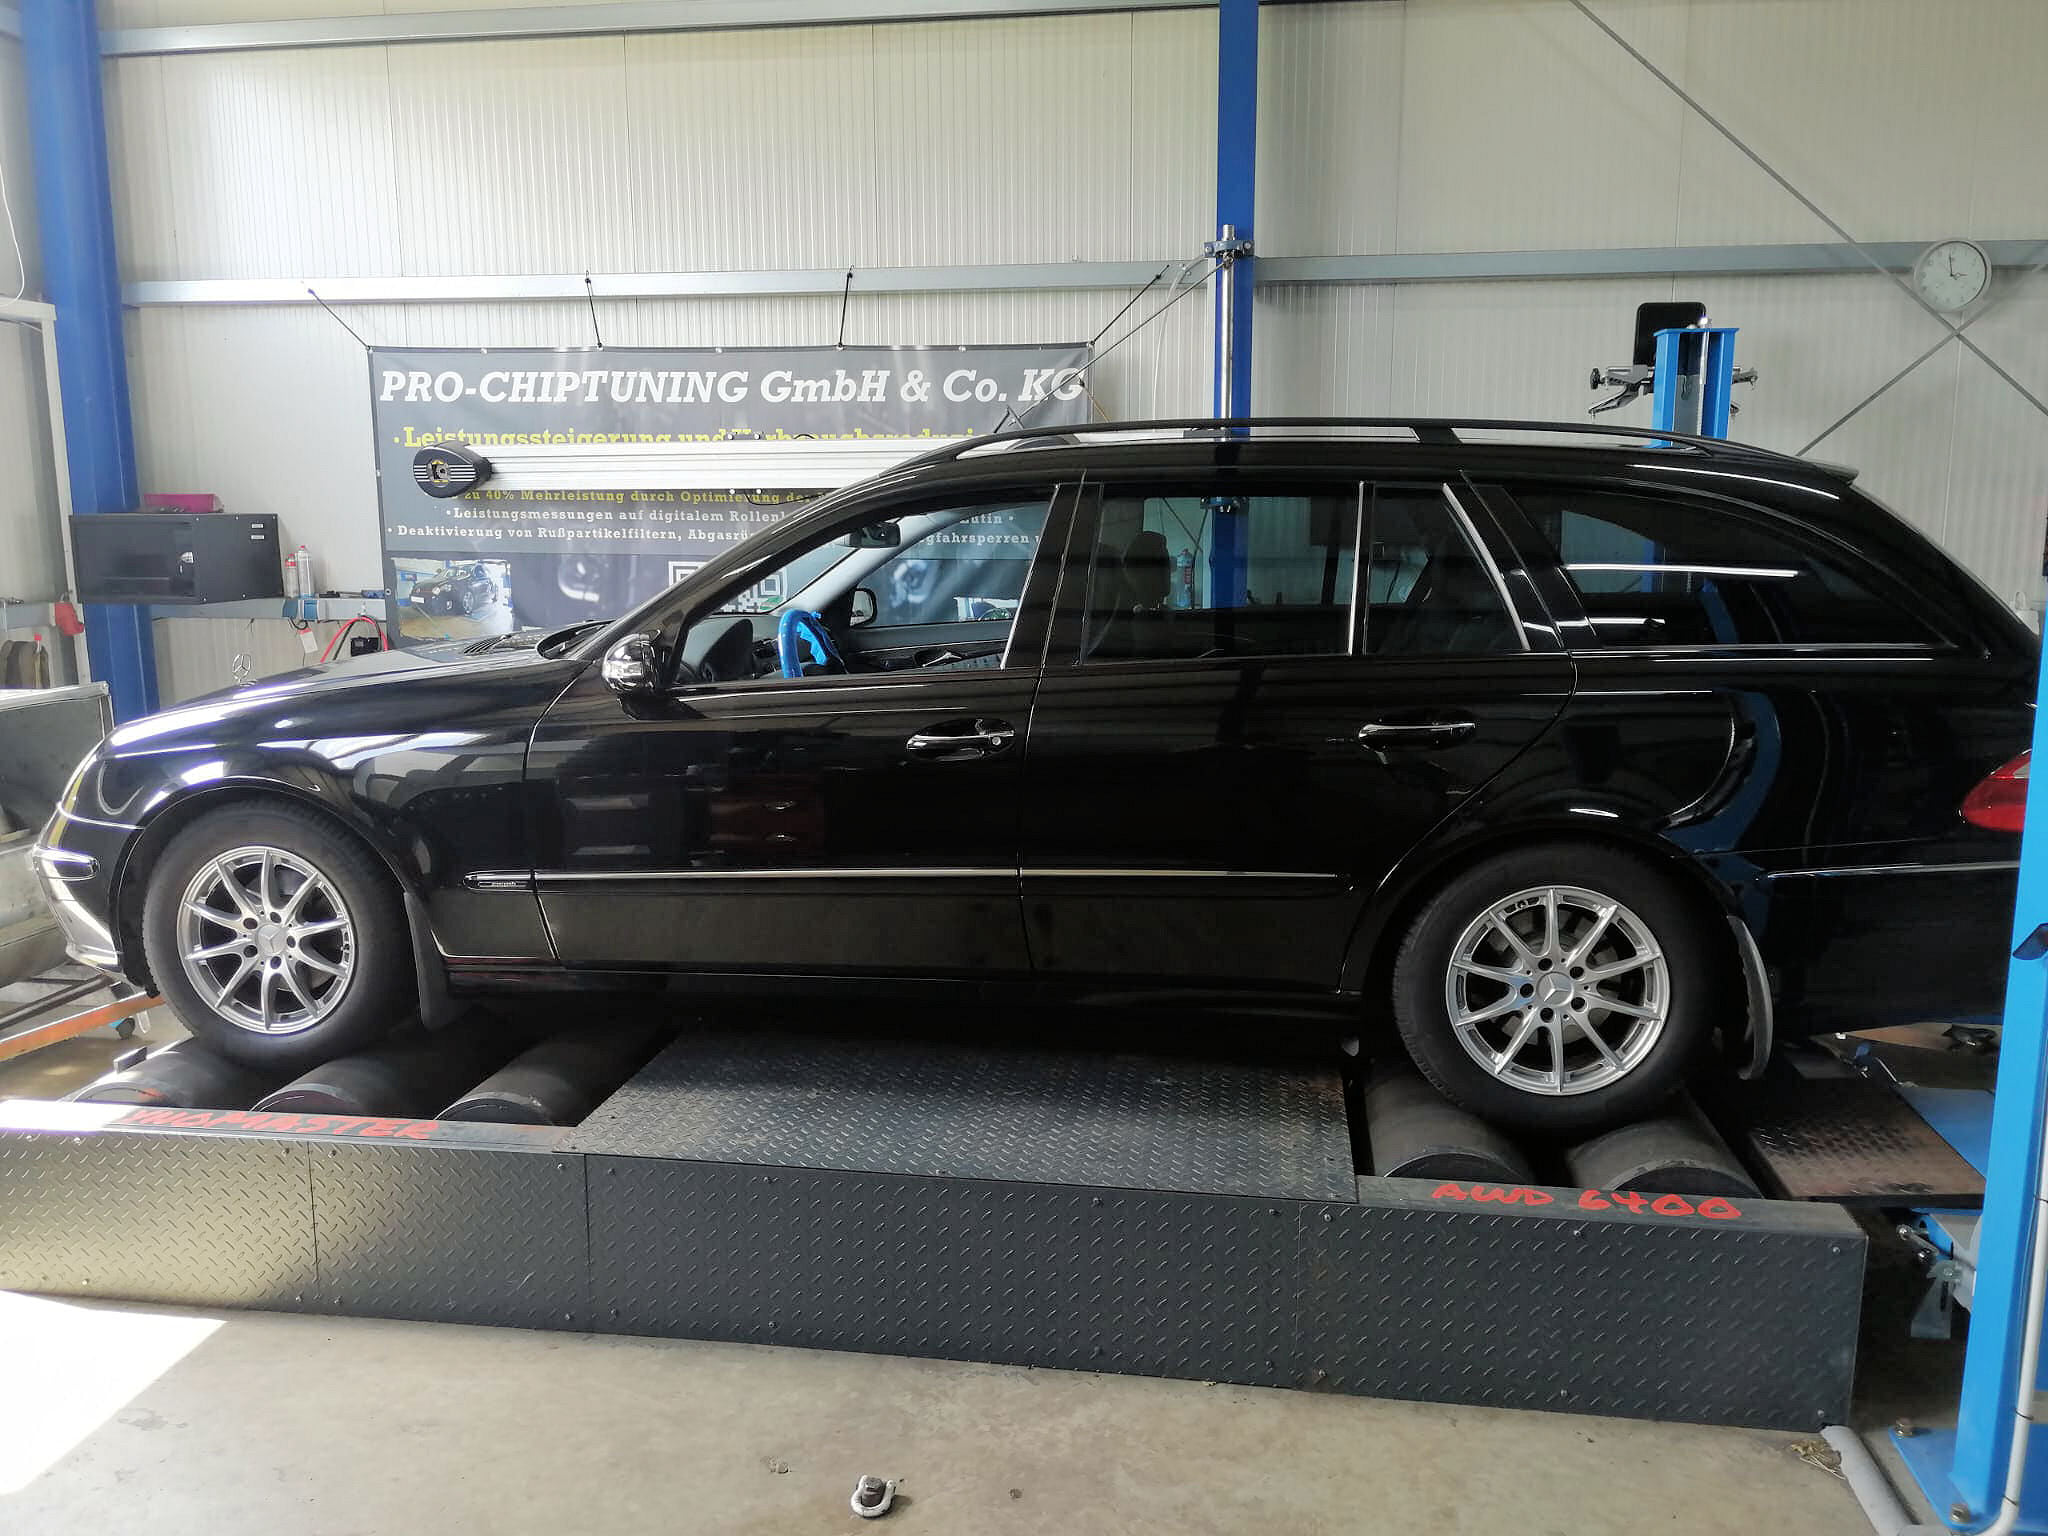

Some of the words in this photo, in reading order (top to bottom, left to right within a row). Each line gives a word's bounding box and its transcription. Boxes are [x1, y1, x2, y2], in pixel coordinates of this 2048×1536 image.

[380, 370, 749, 403] PRO-CHIPTUNING
[760, 369, 891, 402] GmbH
[900, 369, 932, 402] &
[943, 369, 1008, 402] Co.
[1018, 367, 1085, 402] KG
[486, 489, 514, 500] 40%
[521, 490, 625, 504] Mehrleistung
[630, 490, 675, 502] durch
[453, 507, 613, 522] Leistungsmessungen
[619, 510, 644, 521] auf
[649, 509, 724, 523] digitalem
[397, 525, 503, 539] Deaktivierung
[508, 529, 533, 538] von
[537, 527, 682, 542] Rußpartikelfiltern,
[688, 529, 755, 542] Abgasrü
[1431, 1183, 1554, 1206] AWD
[1577, 1189, 1742, 1219] 6400
